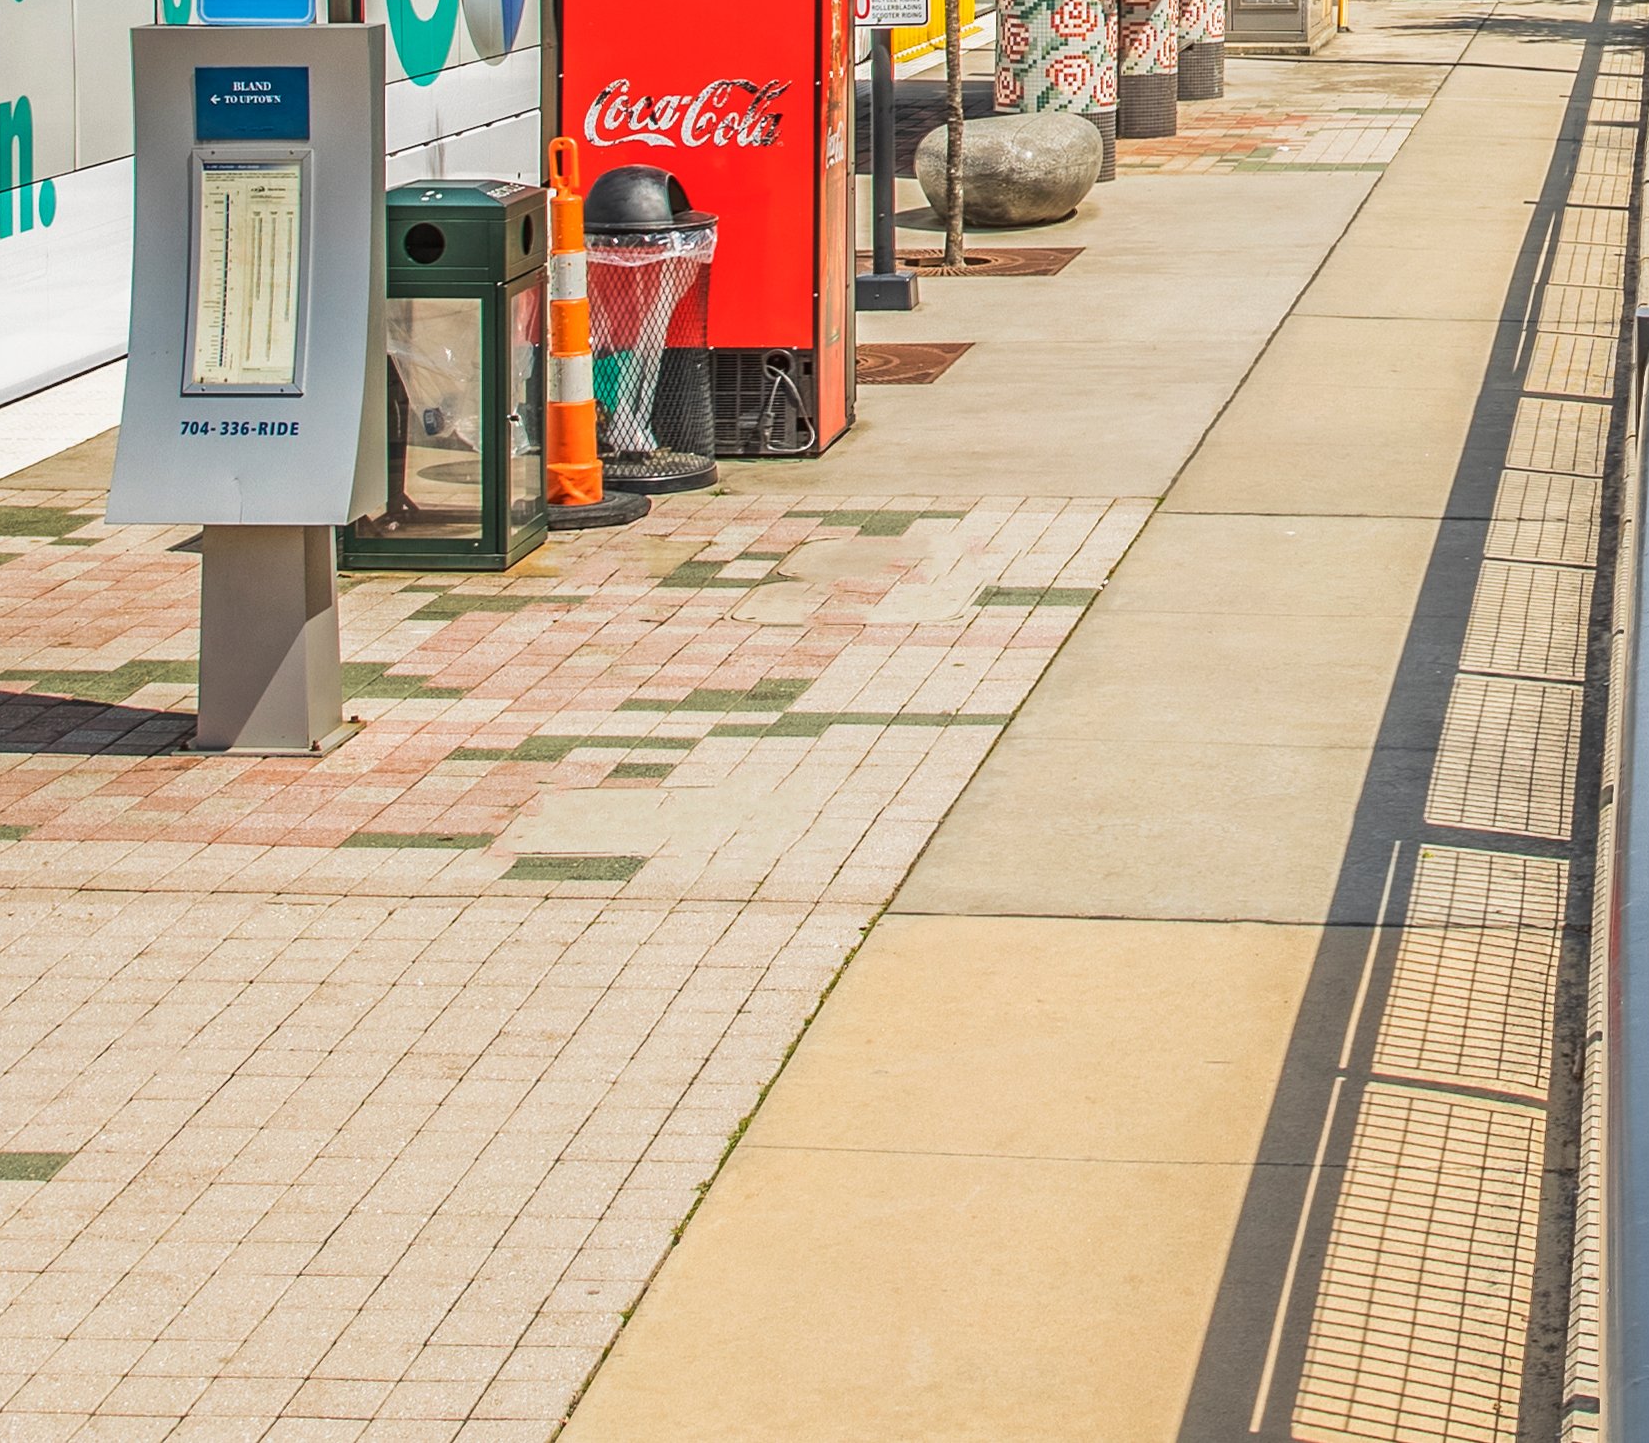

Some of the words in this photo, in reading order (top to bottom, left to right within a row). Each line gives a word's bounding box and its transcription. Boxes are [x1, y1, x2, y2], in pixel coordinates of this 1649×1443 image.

[232, 81, 272, 92] BLAND
[224, 94, 238, 104] TO
[239, 94, 282, 104] UPTOWN
[583, 77, 793, 148] Coca-Cola
